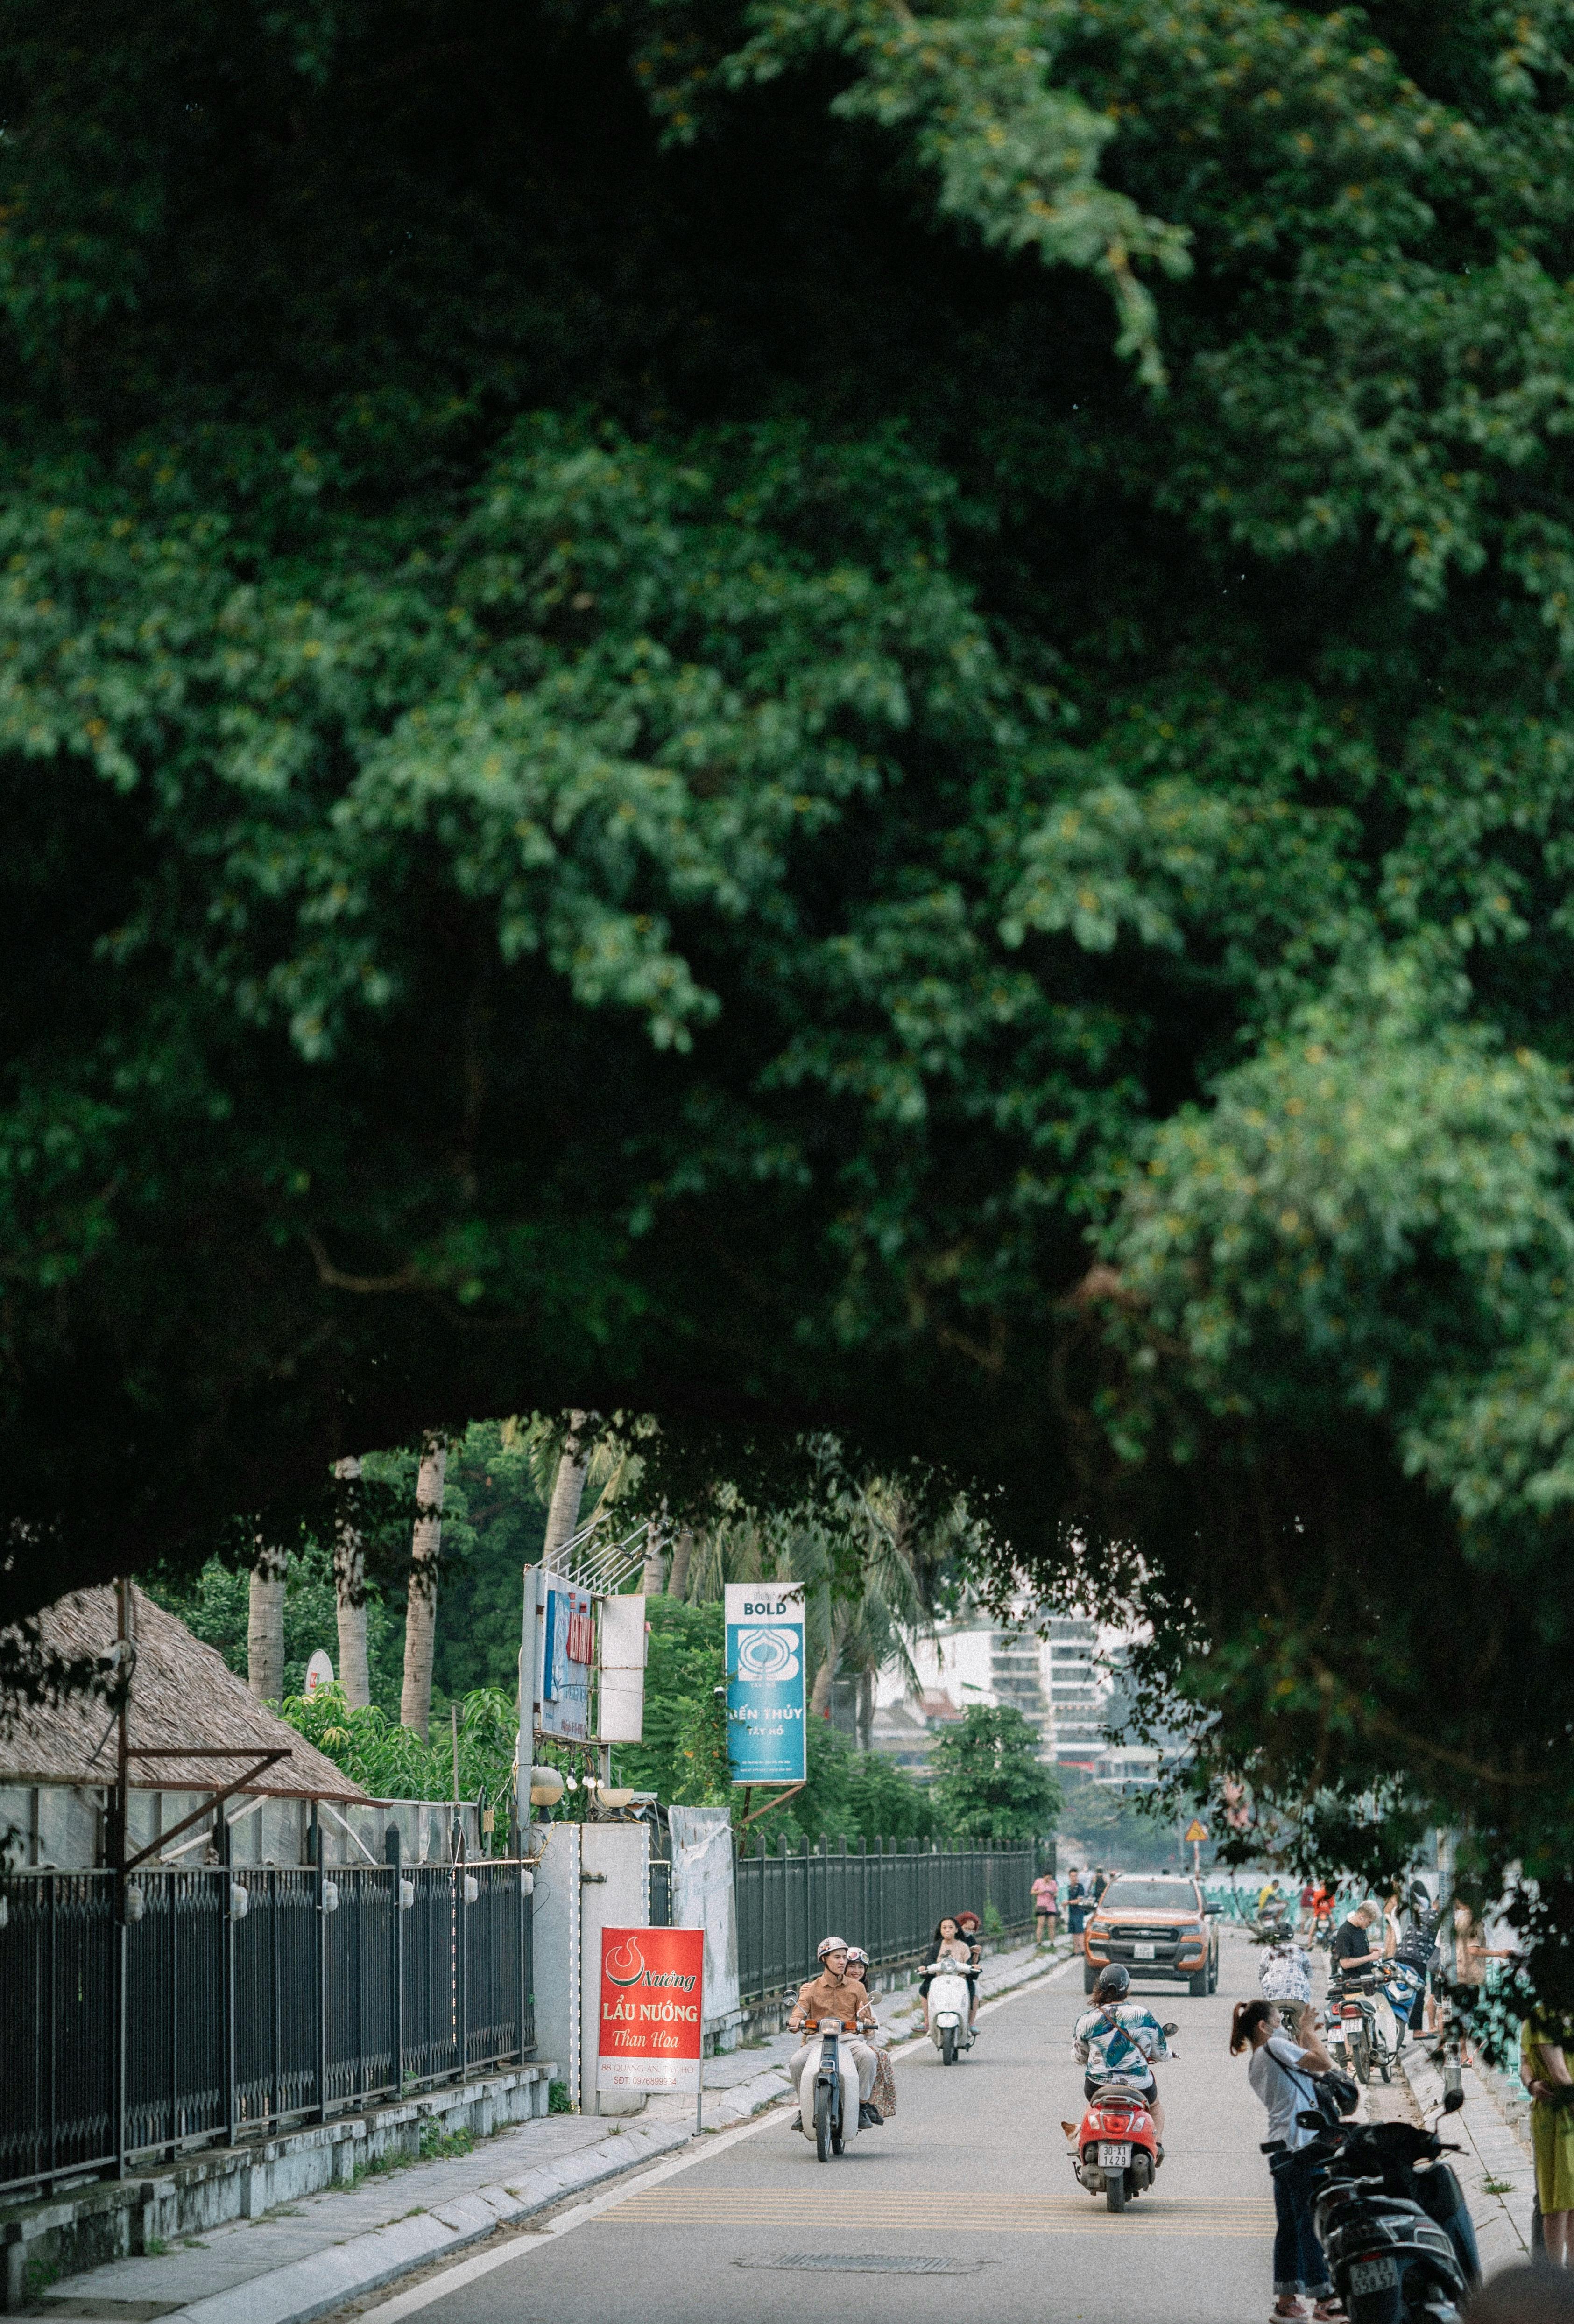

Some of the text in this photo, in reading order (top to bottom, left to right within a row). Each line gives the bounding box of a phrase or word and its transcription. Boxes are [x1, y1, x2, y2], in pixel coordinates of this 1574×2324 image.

[744, 1603, 786, 1615] BOLD
[764, 1704, 803, 1719] THỦY
[642, 1970, 696, 1992] Nướng
[603, 1994, 698, 2022] LẨU NƯỚNG
[613, 2028, 646, 2047] Than
[633, 2077, 676, 2085] 0976899934
[1104, 2146, 1126, 2155] 30-X1
[1104, 2156, 1126, 2165] 1429
